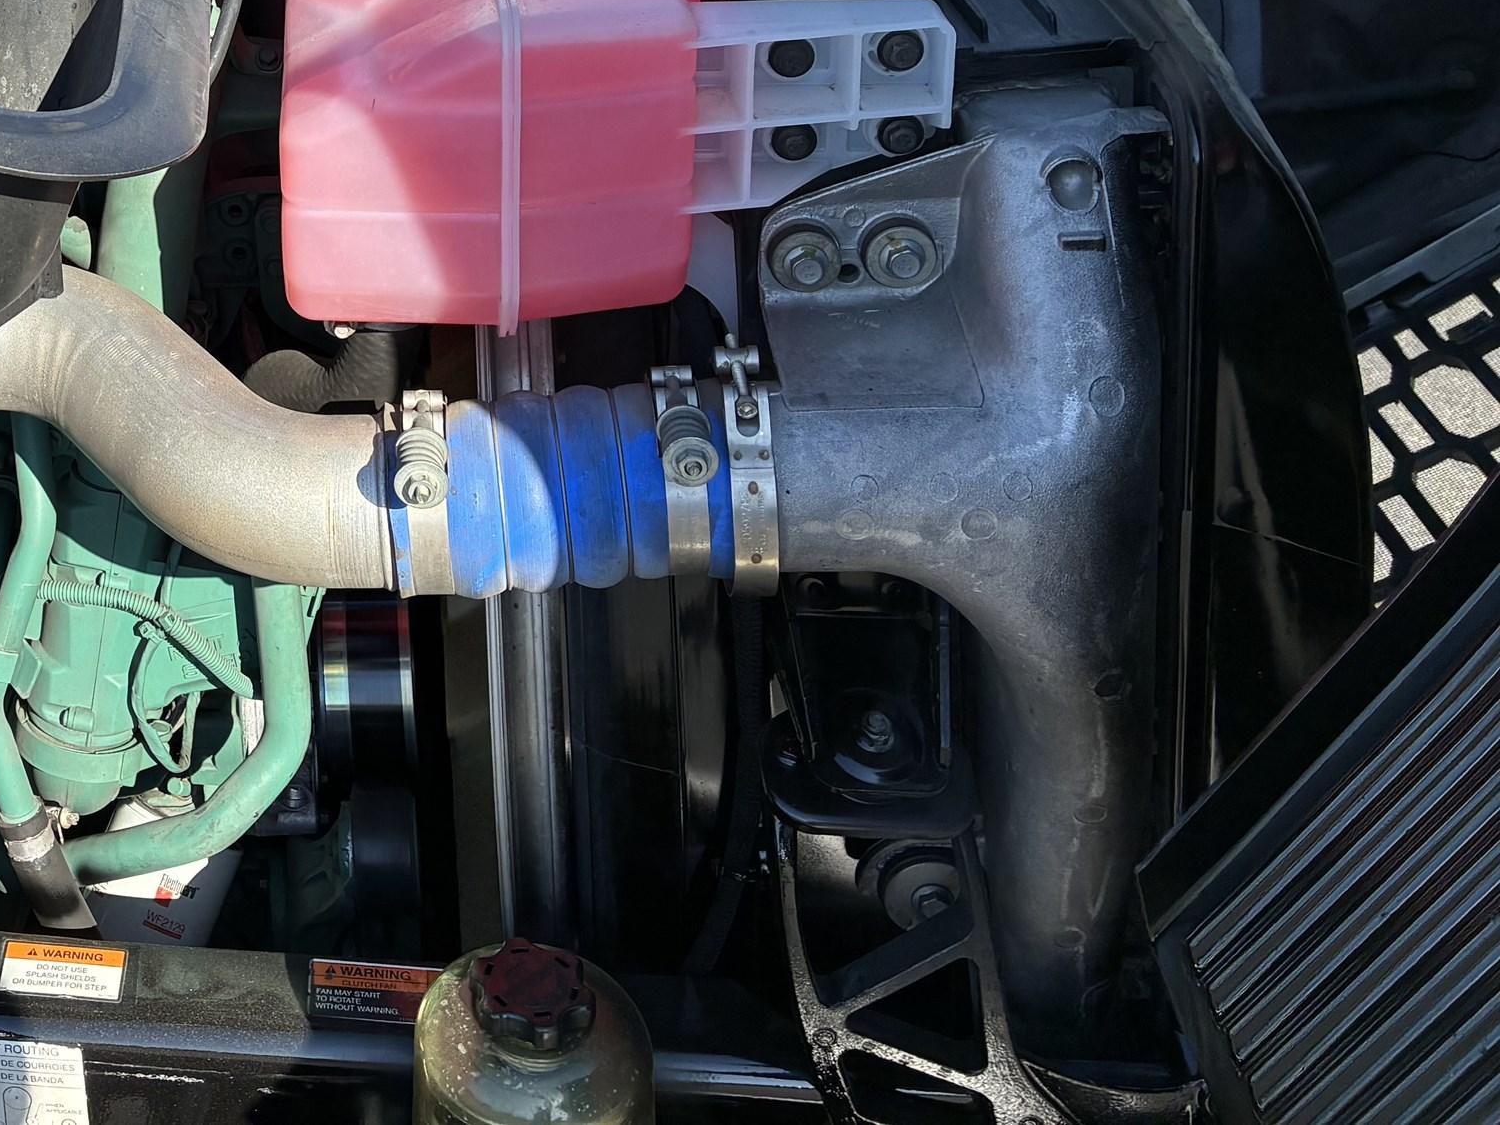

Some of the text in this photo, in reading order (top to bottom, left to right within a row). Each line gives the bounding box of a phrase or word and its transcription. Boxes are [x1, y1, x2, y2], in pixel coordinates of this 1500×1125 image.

[43, 949, 104, 962] WARNING
[51, 964, 68, 972] NOT
[71, 966, 88, 974] USE
[340, 965, 412, 981] WARNING
[25, 970, 97, 983] SPLASH SHIELDS
[26, 978, 63, 988] BUMPER
[65, 981, 83, 990] FOR
[84, 983, 107, 992] STEP
[341, 979, 397, 990] CLUTCH FAN
[315, 987, 381, 999] FAN MAY START
[329, 996, 362, 1005] ROTATE
[315, 1002, 355, 1012] WITHOUT
[4, 1043, 60, 1057] ROUTING
[0, 1059, 15, 1067] DE
[16, 1060, 76, 1072] COURROIES
[0, 1072, 14, 1081] DE
[16, 1073, 29, 1081] LA
[30, 1075, 65, 1084] BANDA
